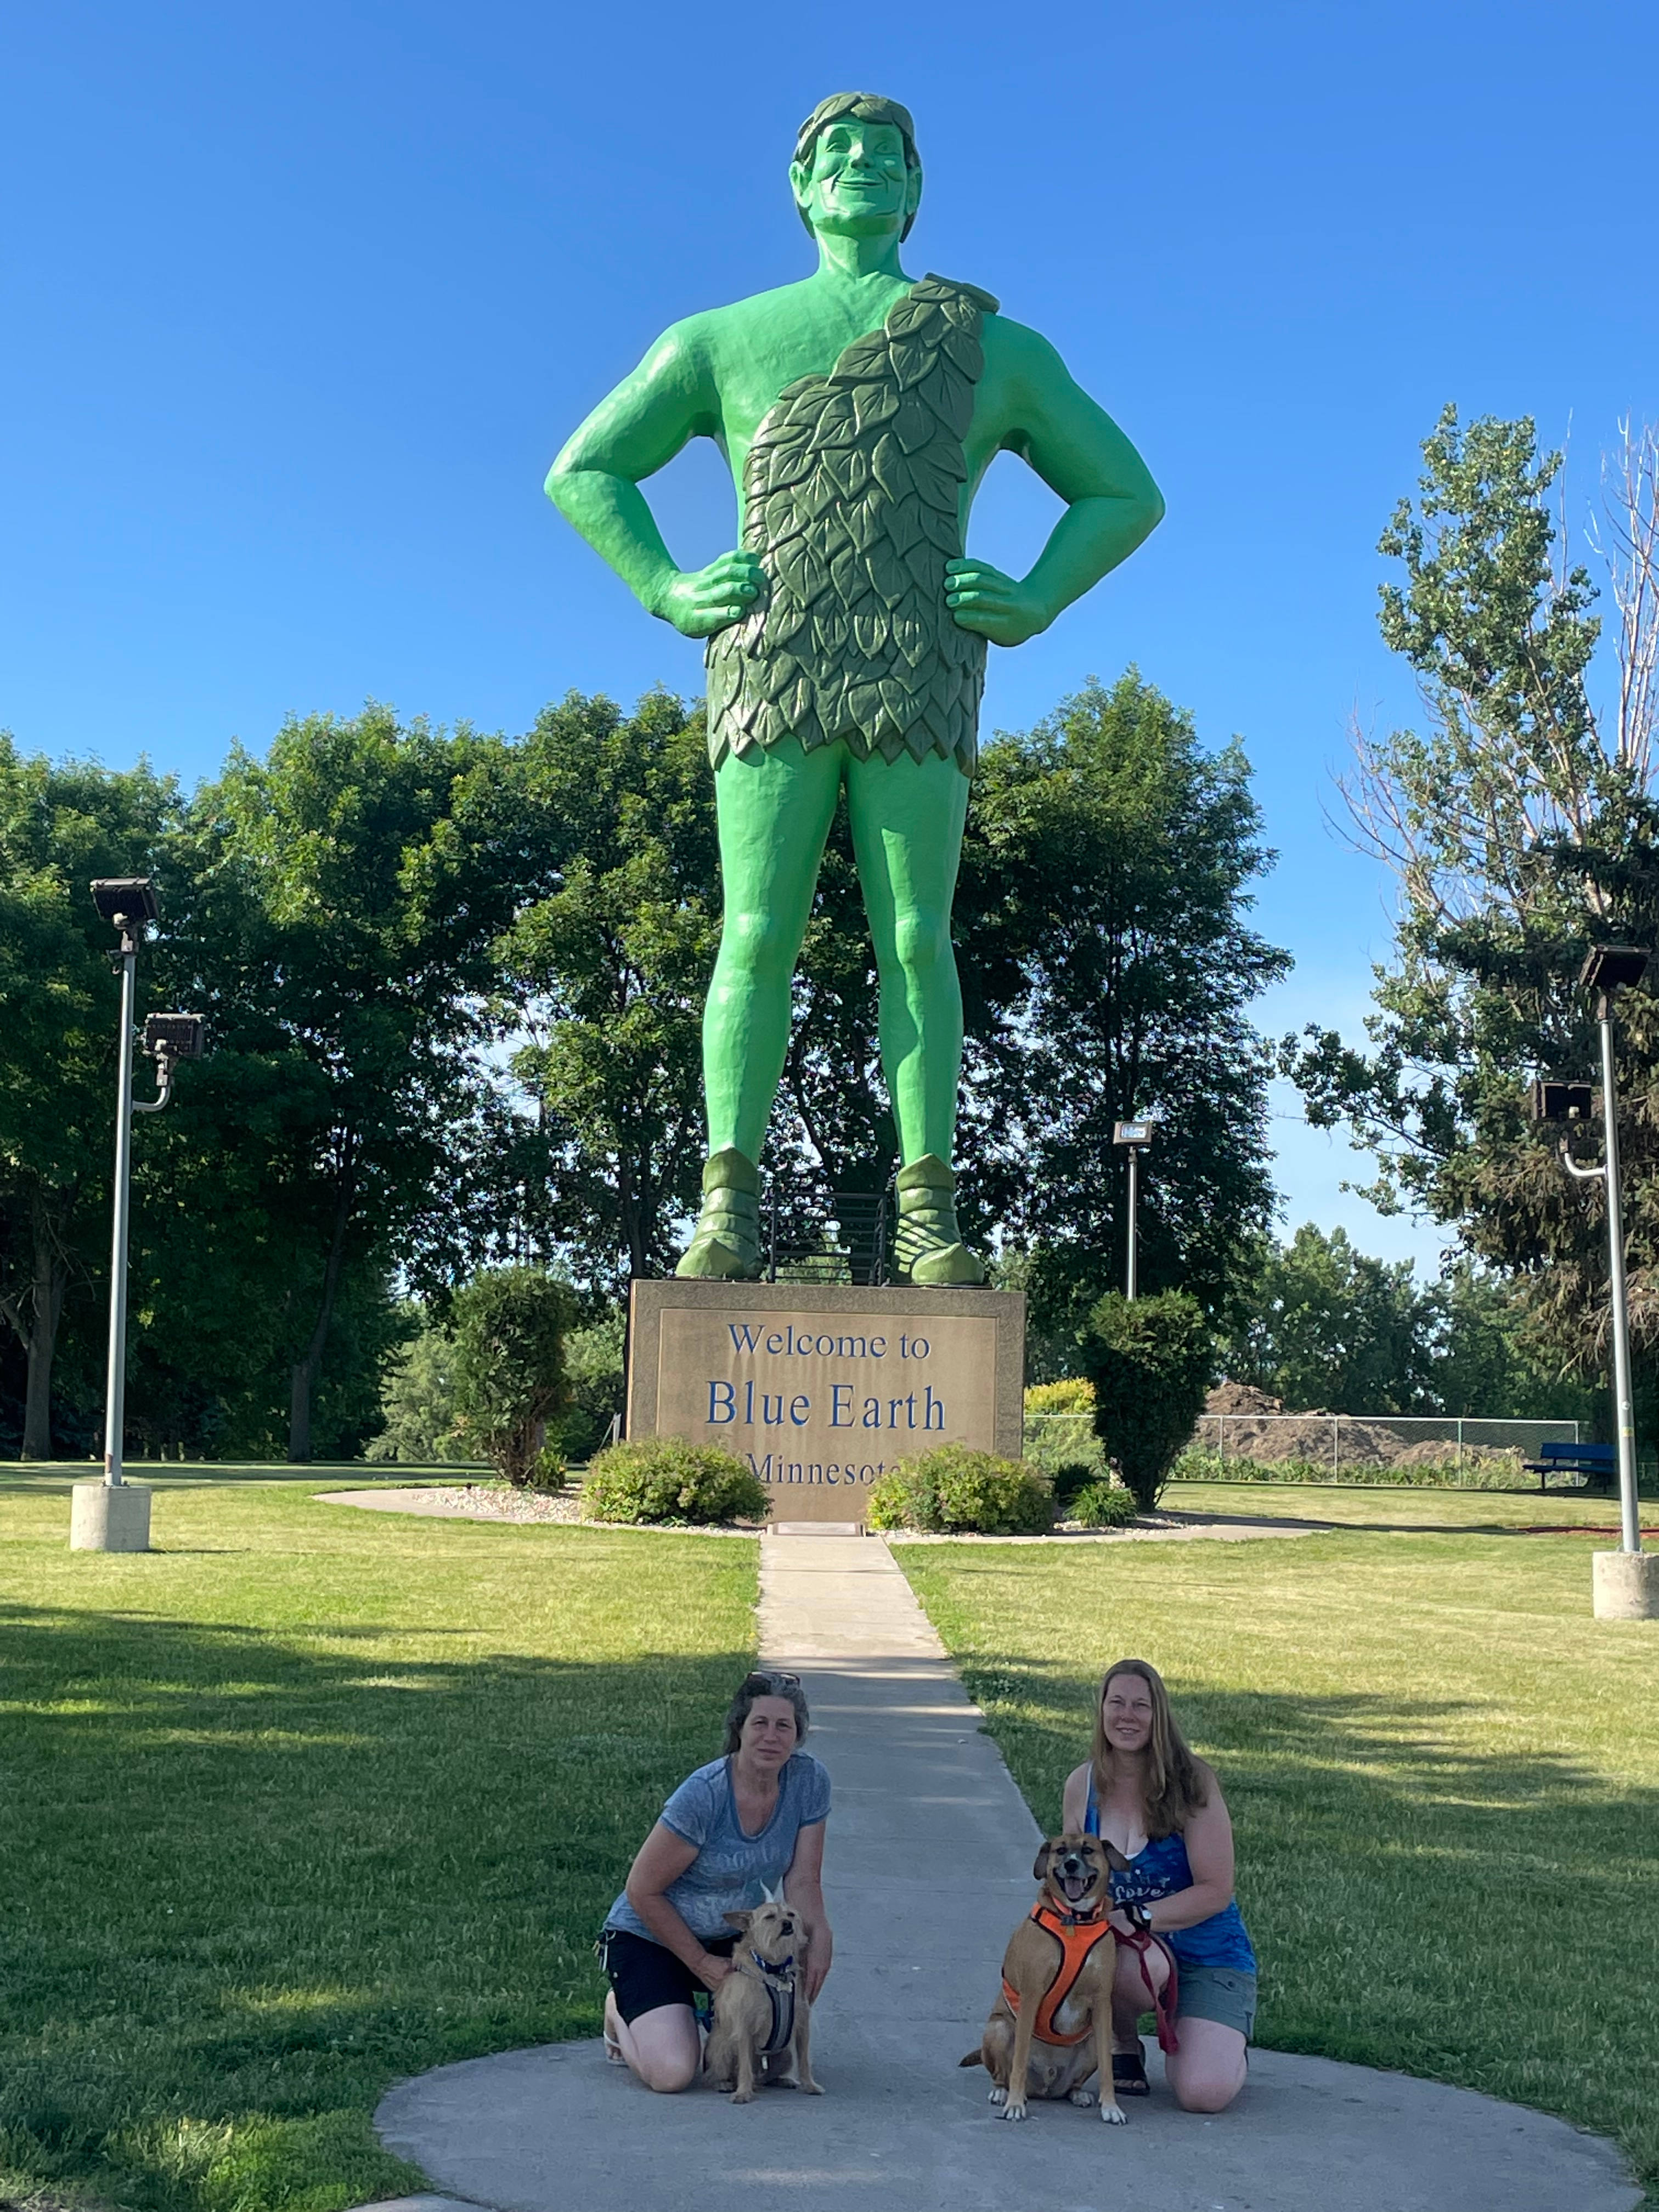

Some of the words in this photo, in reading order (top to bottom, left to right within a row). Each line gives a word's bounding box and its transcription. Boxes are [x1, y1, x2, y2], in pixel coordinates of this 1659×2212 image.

[727, 1323, 887, 1358] Welcome
[899, 1333, 931, 1359] to
[704, 1380, 811, 1426] Blue
[827, 1384, 946, 1431] Earth
